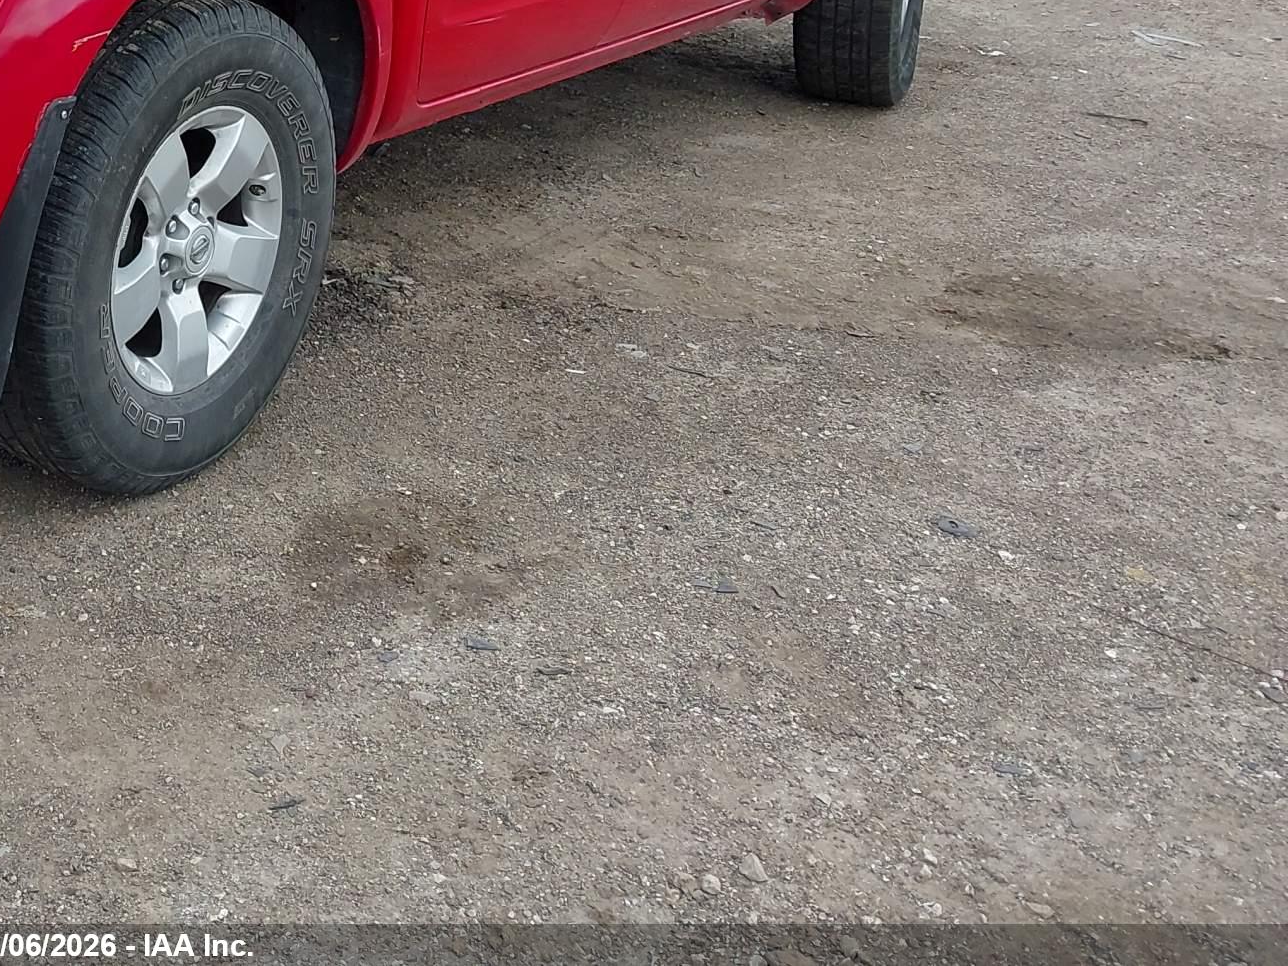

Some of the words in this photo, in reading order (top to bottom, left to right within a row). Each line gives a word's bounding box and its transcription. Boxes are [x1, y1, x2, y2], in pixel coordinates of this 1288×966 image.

[177, 68, 319, 195] DISCOVERER
[282, 217, 317, 318] SRX
[99, 303, 186, 442] COOPER
